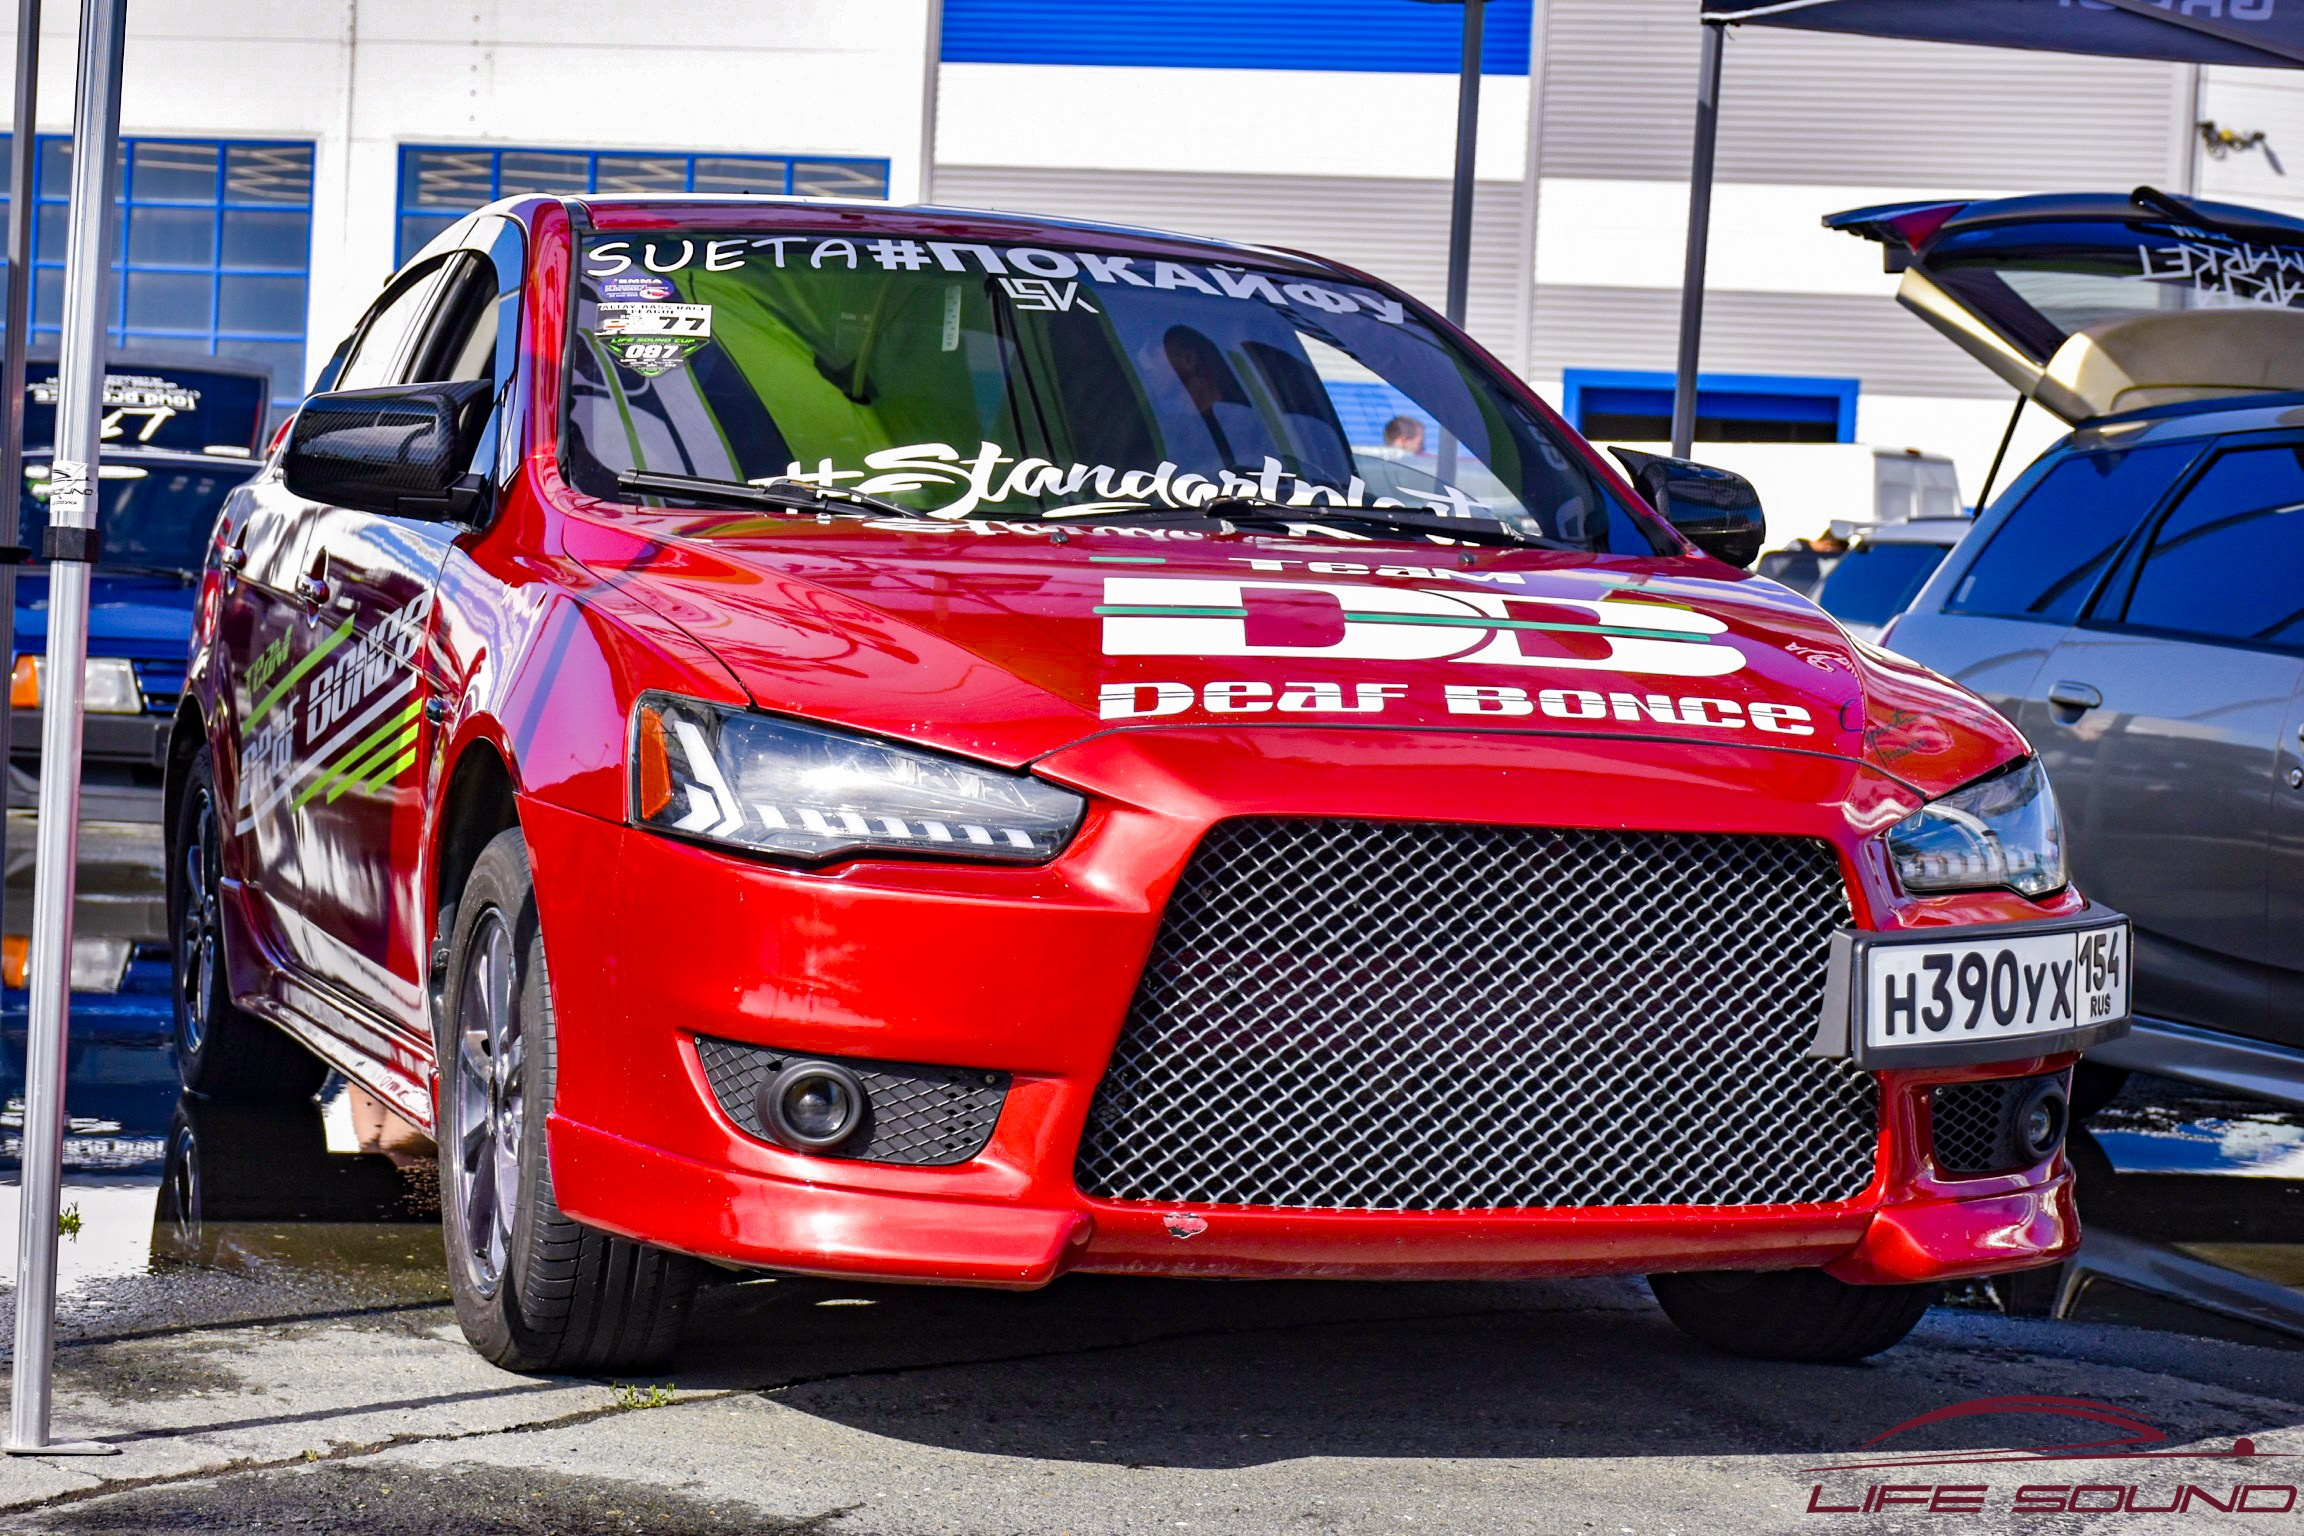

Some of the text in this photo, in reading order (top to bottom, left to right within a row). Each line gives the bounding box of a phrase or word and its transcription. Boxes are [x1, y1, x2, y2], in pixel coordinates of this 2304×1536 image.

[624, 344, 679, 359] 097
[2078, 931, 2120, 993] 154
[2089, 993, 2111, 1018] RUS
